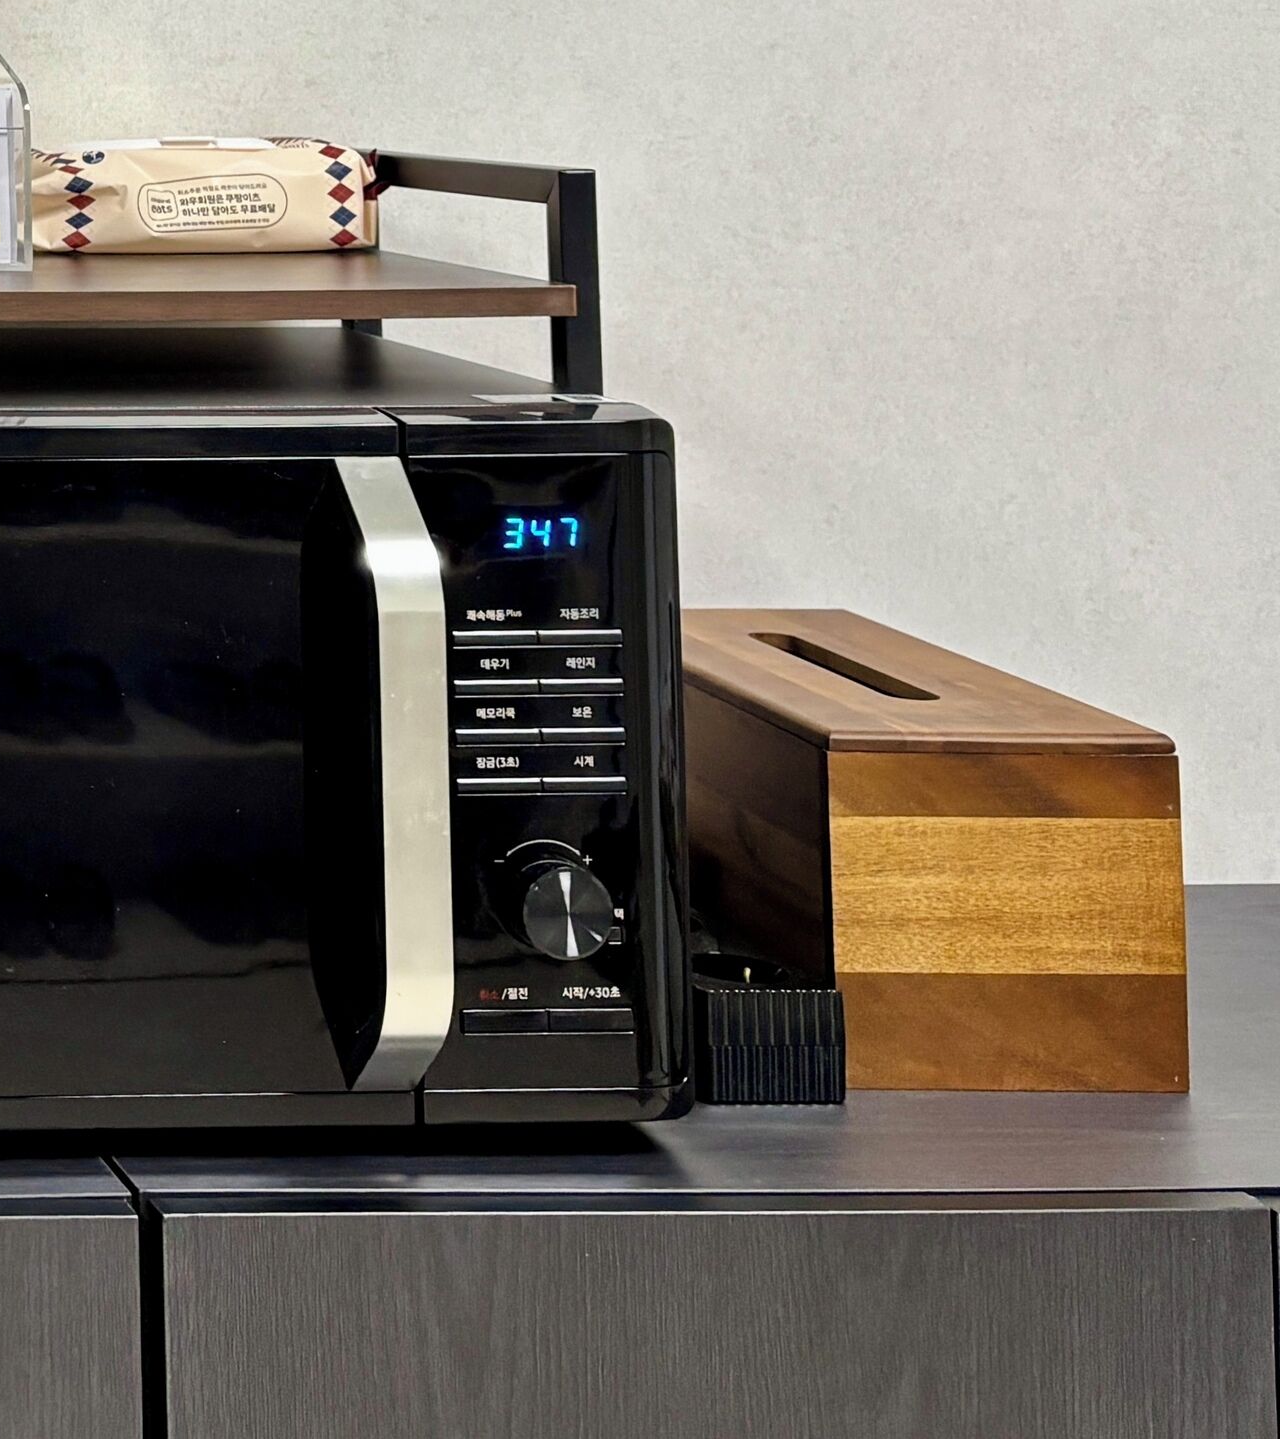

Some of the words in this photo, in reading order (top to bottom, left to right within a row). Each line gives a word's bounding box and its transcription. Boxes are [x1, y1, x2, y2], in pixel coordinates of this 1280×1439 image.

[503, 517, 578, 549] 347
[560, 608, 600, 620] 자동조리
[480, 658, 510, 670] 데우기
[566, 657, 596, 669] 레인지
[574, 755, 595, 768] 시계
